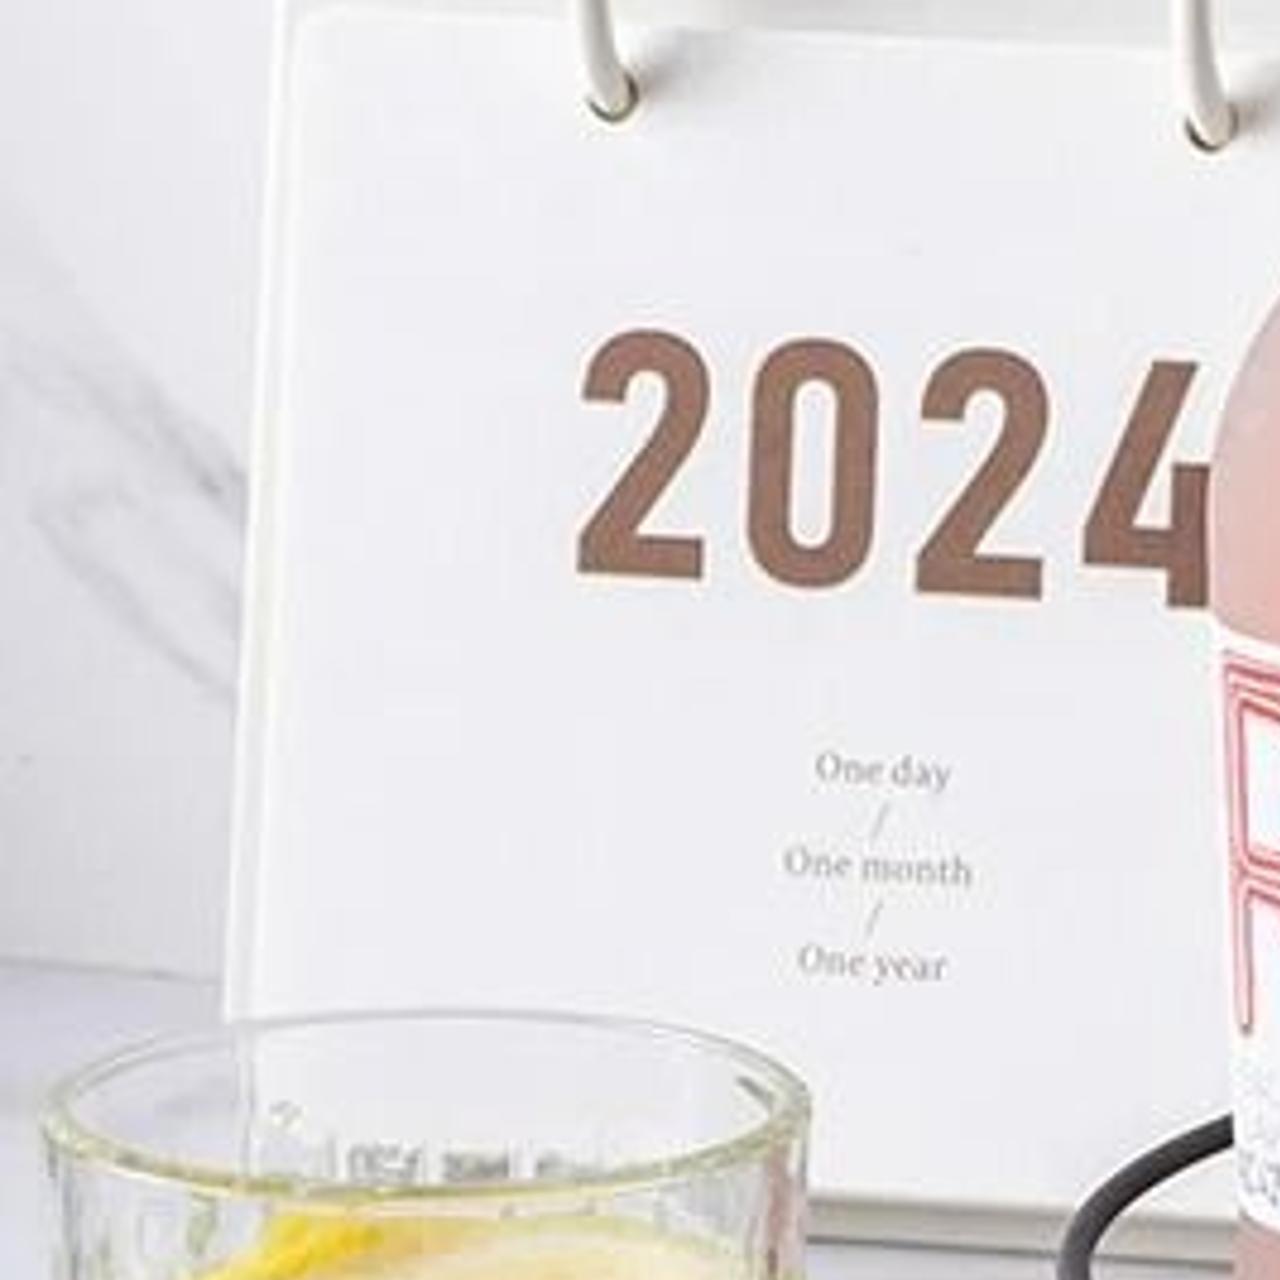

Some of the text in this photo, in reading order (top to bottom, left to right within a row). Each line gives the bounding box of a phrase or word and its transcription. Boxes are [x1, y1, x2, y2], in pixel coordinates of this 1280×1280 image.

[576, 328, 1211, 608] 2024
[814, 751, 952, 795] One day
[783, 845, 972, 888] One month
[799, 943, 948, 988] One year
